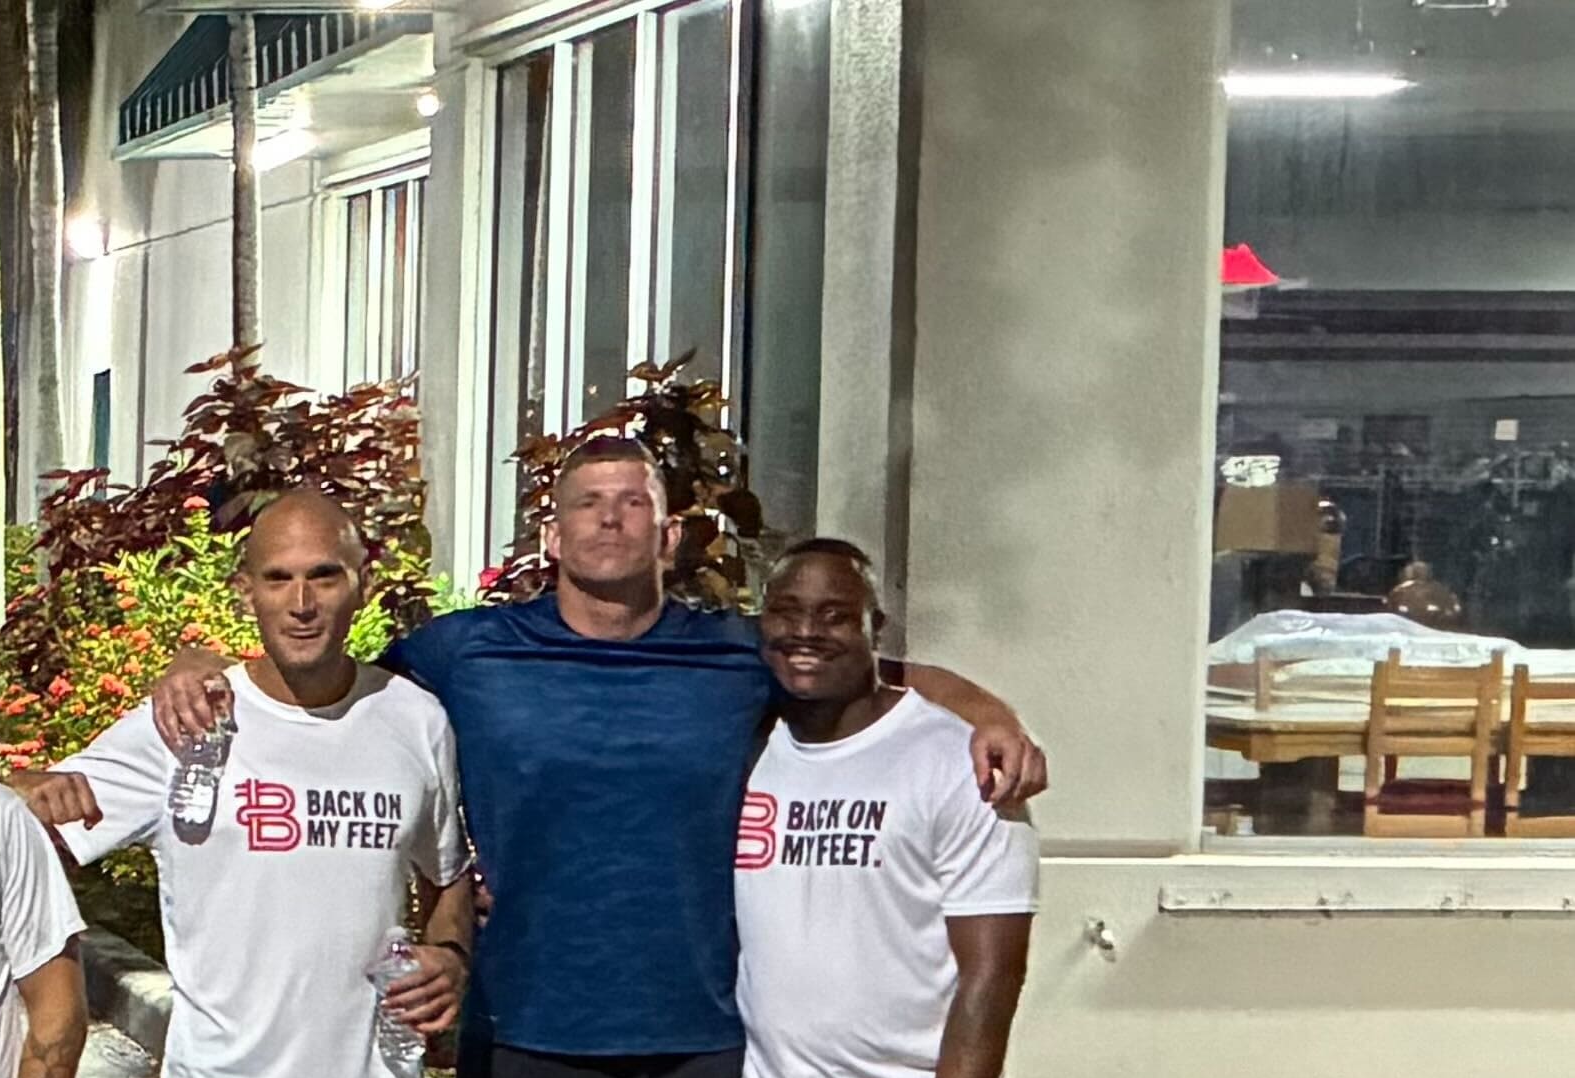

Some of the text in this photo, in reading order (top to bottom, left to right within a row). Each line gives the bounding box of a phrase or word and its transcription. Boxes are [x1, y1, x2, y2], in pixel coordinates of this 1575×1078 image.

[306, 789, 402, 820] BACK ON
[786, 798, 887, 831] BACK ON
[306, 819, 341, 848] MY
[781, 833, 882, 868] MY FEET.
